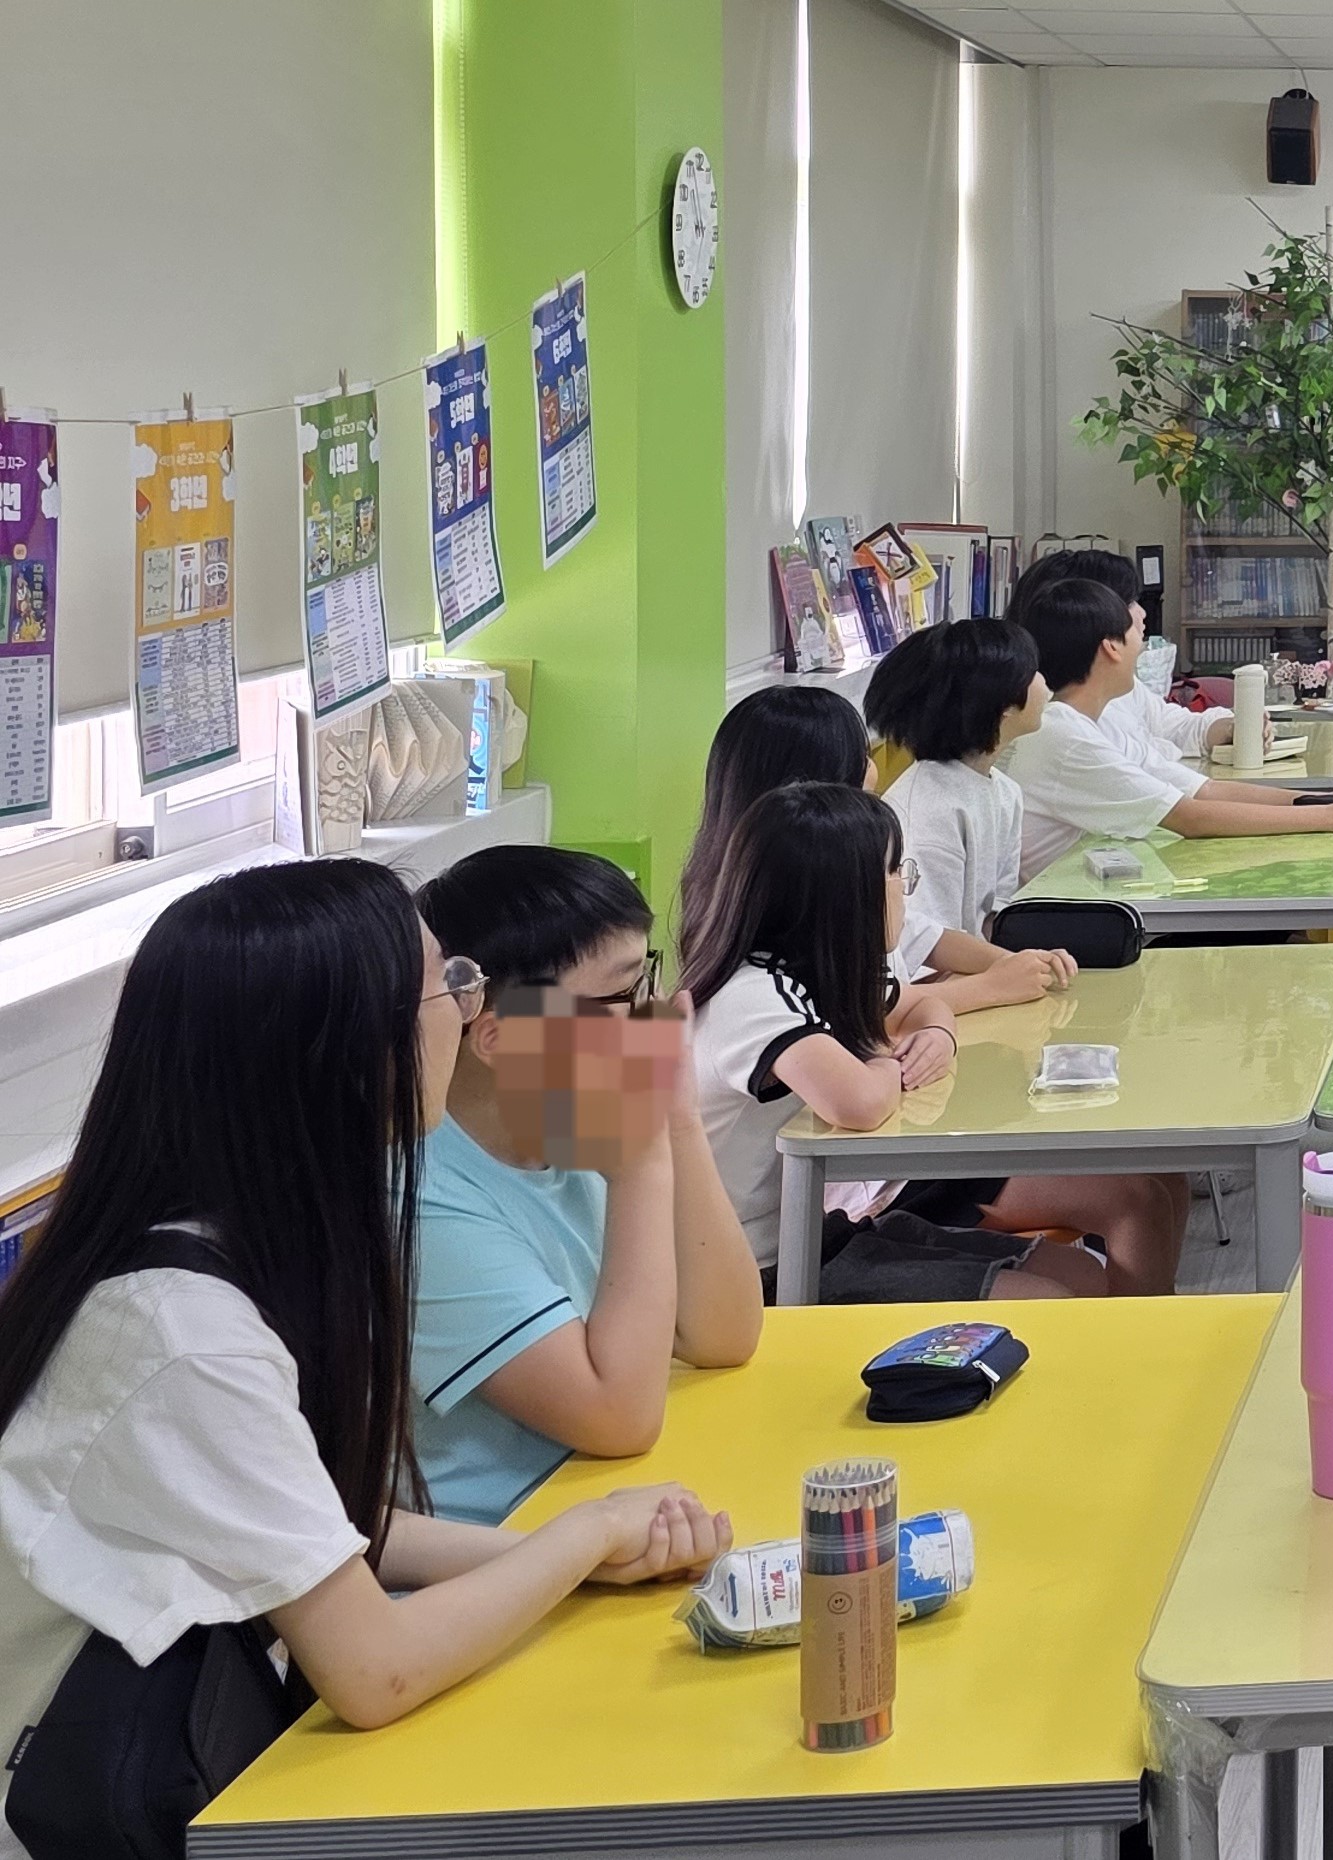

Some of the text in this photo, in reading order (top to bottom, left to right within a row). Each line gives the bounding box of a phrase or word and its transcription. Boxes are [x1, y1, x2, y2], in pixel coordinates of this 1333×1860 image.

[450, 393, 475, 429] 5학년
[329, 442, 358, 478] 4학년
[170, 474, 208, 512] 3학년
